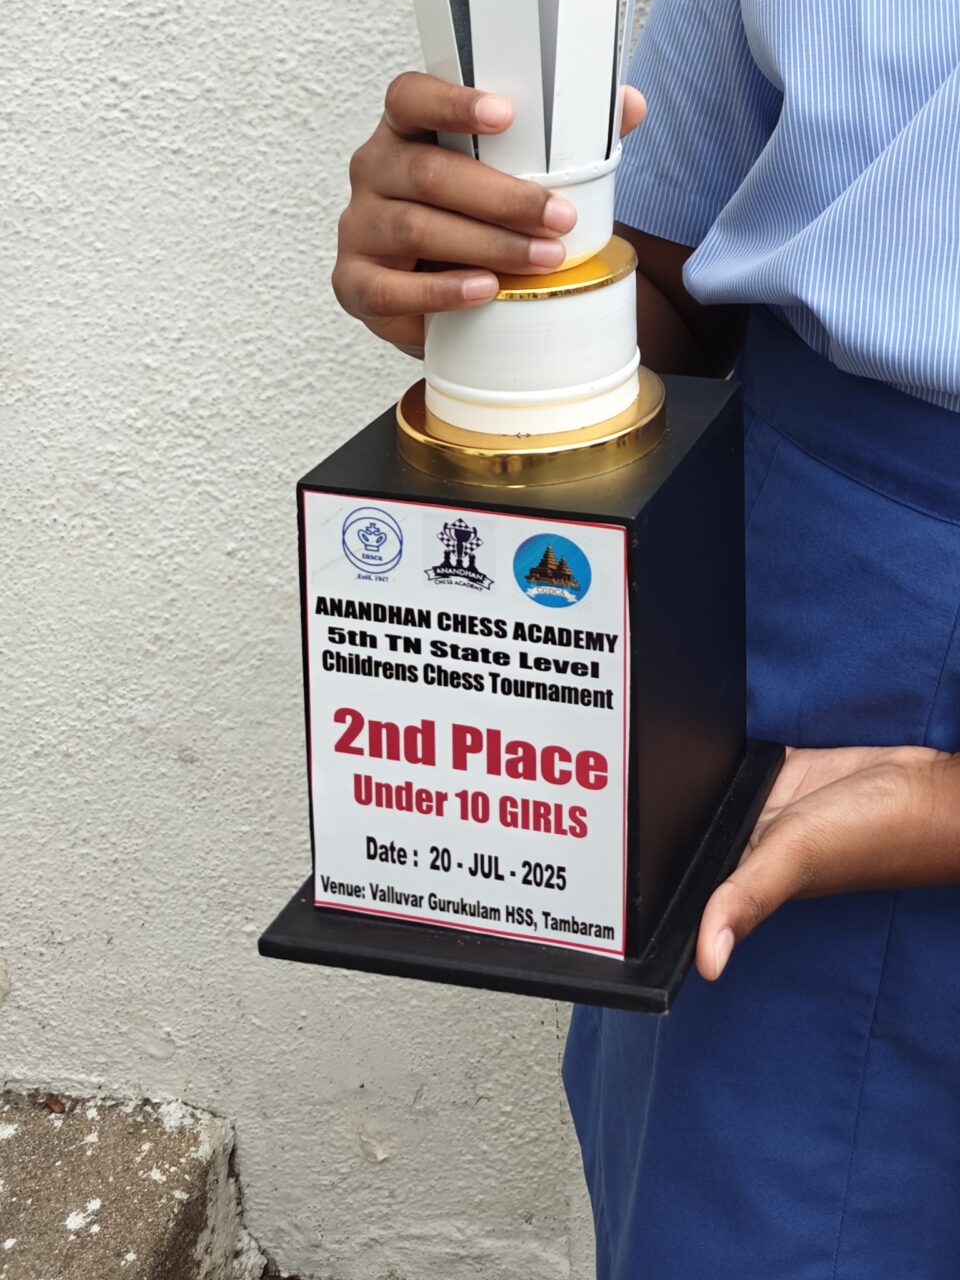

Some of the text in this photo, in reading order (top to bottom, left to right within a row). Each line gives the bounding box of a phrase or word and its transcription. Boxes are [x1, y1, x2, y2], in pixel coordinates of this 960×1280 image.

[436, 568, 484, 581] ANANDHAN
[455, 580, 483, 591] ACADEMY
[315, 596, 619, 653] ANANDHAN CHESS ACADEMY
[327, 626, 600, 679] 5th TN State Level
[322, 649, 614, 709] Childrens Chess Tournament
[333, 707, 609, 791] 2nd Place
[353, 773, 588, 839] Under 10 GIRLS
[430, 846, 451, 872] 20
[468, 853, 505, 881] JUL
[521, 860, 567, 891] 2025
[321, 875, 615, 940] Venue: Valluvar Gurukulam HSS, Tambaram
